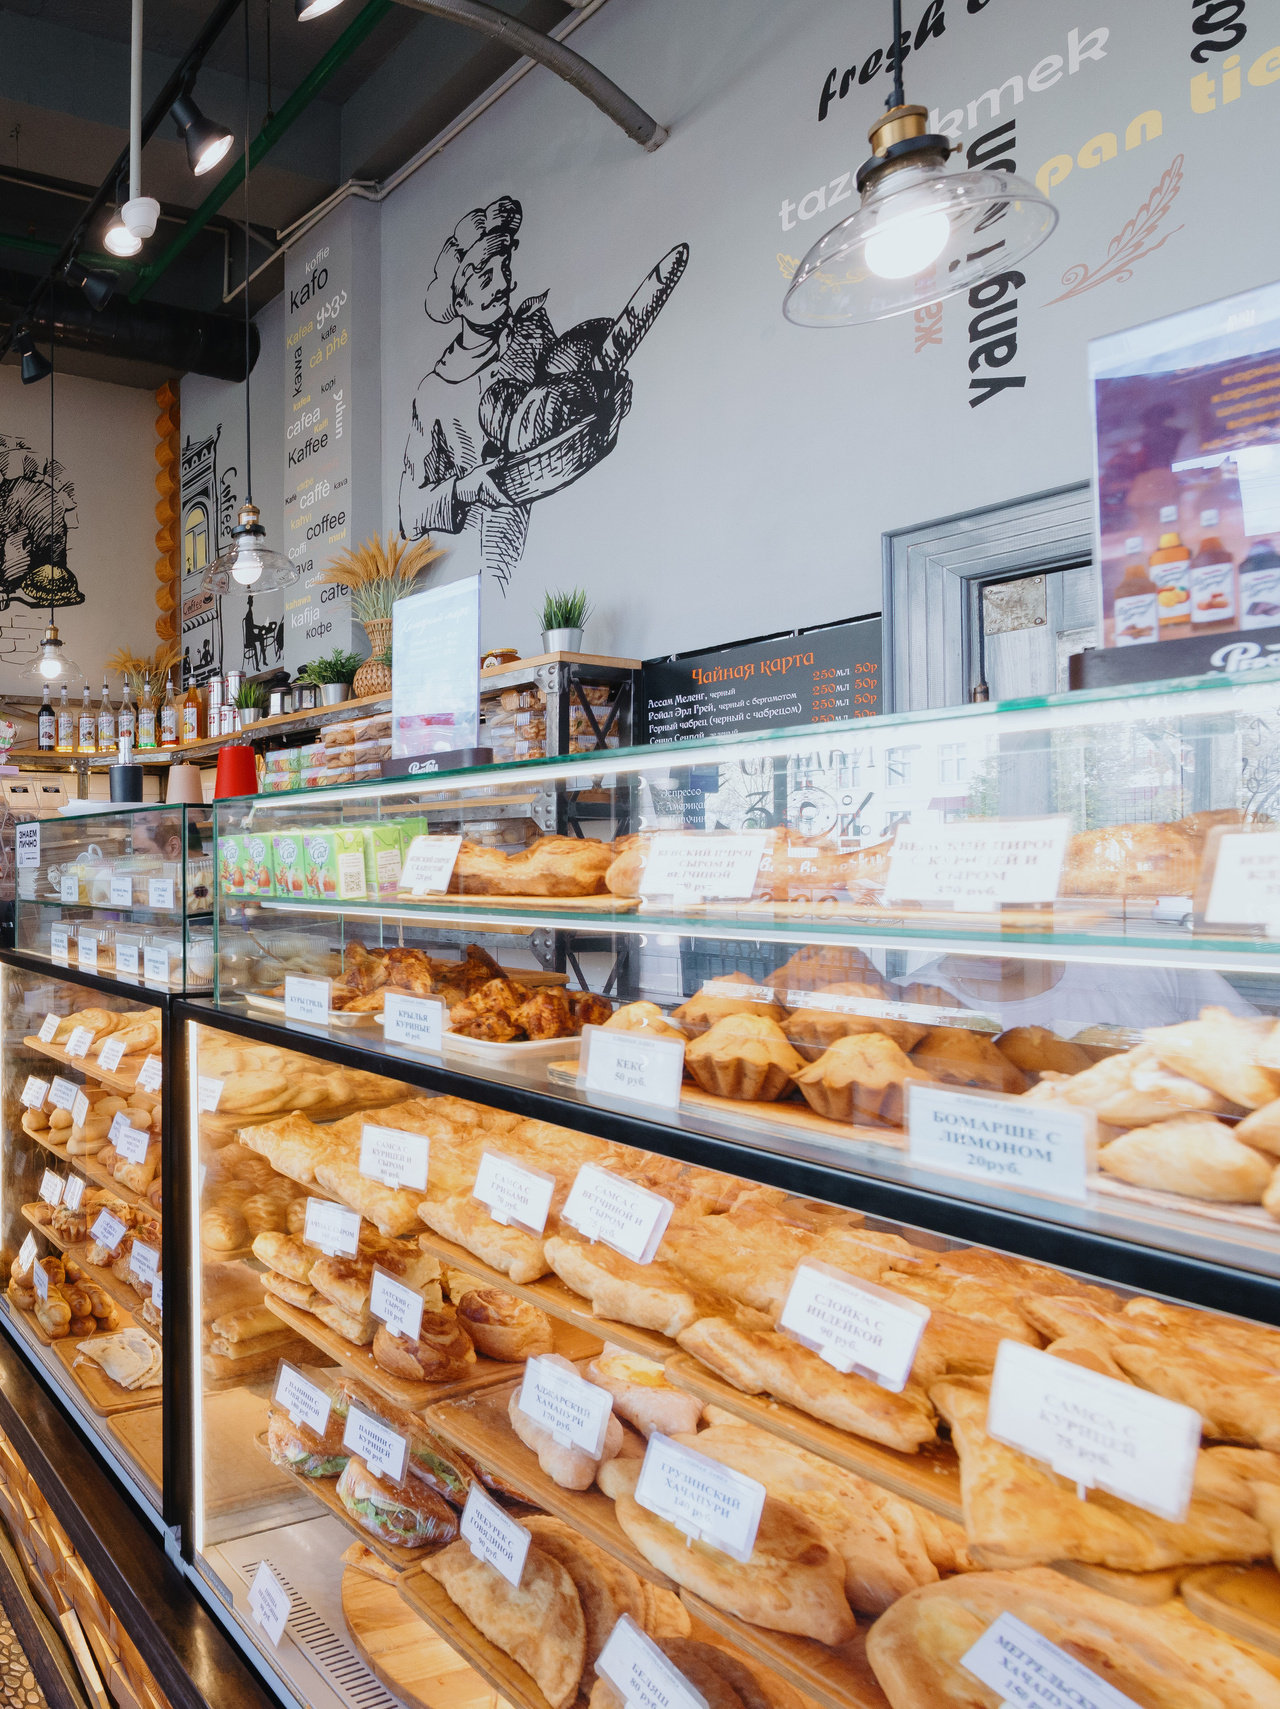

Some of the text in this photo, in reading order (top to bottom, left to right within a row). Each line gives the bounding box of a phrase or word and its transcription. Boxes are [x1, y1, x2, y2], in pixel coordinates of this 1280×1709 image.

[818, 0, 946, 121] fresh
[778, 159, 863, 231] taz
[930, 27, 1110, 140] kmek
[1035, 109, 1163, 199] pan
[305, 246, 330, 275] koffie
[290, 268, 329, 314] kafo
[286, 320, 314, 350] Kafea
[292, 346, 303, 398] kawa
[320, 375, 337, 394] kopi
[286, 406, 321, 440] cafea
[288, 433, 329, 468] Kaffee
[333, 477, 348, 490] kava
[306, 511, 346, 541] coffee
[295, 559, 314, 576] ava
[291, 606, 320, 629] kafija
[306, 621, 333, 640] кофе
[691, 652, 815, 685] Чайная карта
[648, 697, 673, 709] Ассам
[709, 687, 736, 699] черный
[854, 662, 878, 675] 50р
[648, 709, 674, 721] Ройал
[674, 706, 692, 718] Эрл
[693, 702, 717, 715] Грей,
[718, 699, 744, 711] черный
[751, 691, 797, 705] бергамотом
[854, 677, 878, 690] 50р
[649, 722, 678, 734] Горный
[679, 718, 708, 731] чабрец
[709, 712, 744, 727] (черный
[752, 704, 803, 719] чабрецом)
[854, 692, 878, 705] 50р
[661, 788, 702, 799] Эспрессо
[18, 829, 38, 839] ЗНАЕМ
[18, 839, 38, 849] ЛИЧНО
[290, 994, 306, 1004] КУРЫ
[395, 1019, 431, 1034] КУРИНЫЕ
[398, 1009, 428, 1022] КРЫЛЬЯ
[615, 1058, 646, 1072] КЕКС
[614, 1072, 647, 1088] 50 руб.
[932, 1110, 1061, 1146] БОМАРШЕ С
[376, 1139, 402, 1153] САМСА
[938, 1129, 1053, 1164] ЛИМОНОМ
[377, 1159, 405, 1172] СЫРОМ
[966, 1152, 1024, 1176] 20руб.
[491, 1181, 530, 1206] ГРИБАМИ
[494, 1172, 532, 1195] САМСА С
[582, 1189, 644, 1227] ВЕТЧИНОЙ И
[594, 1184, 638, 1211] САМСА С
[589, 1205, 626, 1231] СЫРОМ
[598, 1225, 616, 1239] руб.
[381, 1287, 408, 1307] ДАТСКИЙ
[384, 1299, 406, 1316] СЫРОМ
[814, 1293, 871, 1327] СЛОЙКА
[873, 1319, 886, 1332] С
[805, 1303, 885, 1349] ИНДЕЙКОЙ
[820, 1326, 859, 1353] 90 руб.
[284, 1386, 320, 1417] ГОВЯДИНОЙ
[289, 1380, 314, 1403] ПАНИНИ
[533, 1383, 591, 1419] АДЖАРСКИЙ
[535, 1394, 585, 1428] ХАЧАПУРИ
[542, 1410, 572, 1433] 170 руб.
[358, 1424, 395, 1450] ПАНИНИ С
[358, 1433, 391, 1459] КУРИЦЕЙ
[361, 1445, 384, 1465] 150 руб.
[661, 1461, 741, 1511] ГРУЗИНСКИЙ
[664, 1477, 731, 1520] ХАЧАПУРИ
[475, 1508, 515, 1550] ЧЕБУРЕК С
[691, 1508, 713, 1525] руб.
[470, 1516, 514, 1562] ГОВЯДИНОЙ
[478, 1537, 499, 1561] 90 руб.
[629, 1677, 641, 1692] 80
[631, 1662, 670, 1708] БЕЛЯШ
